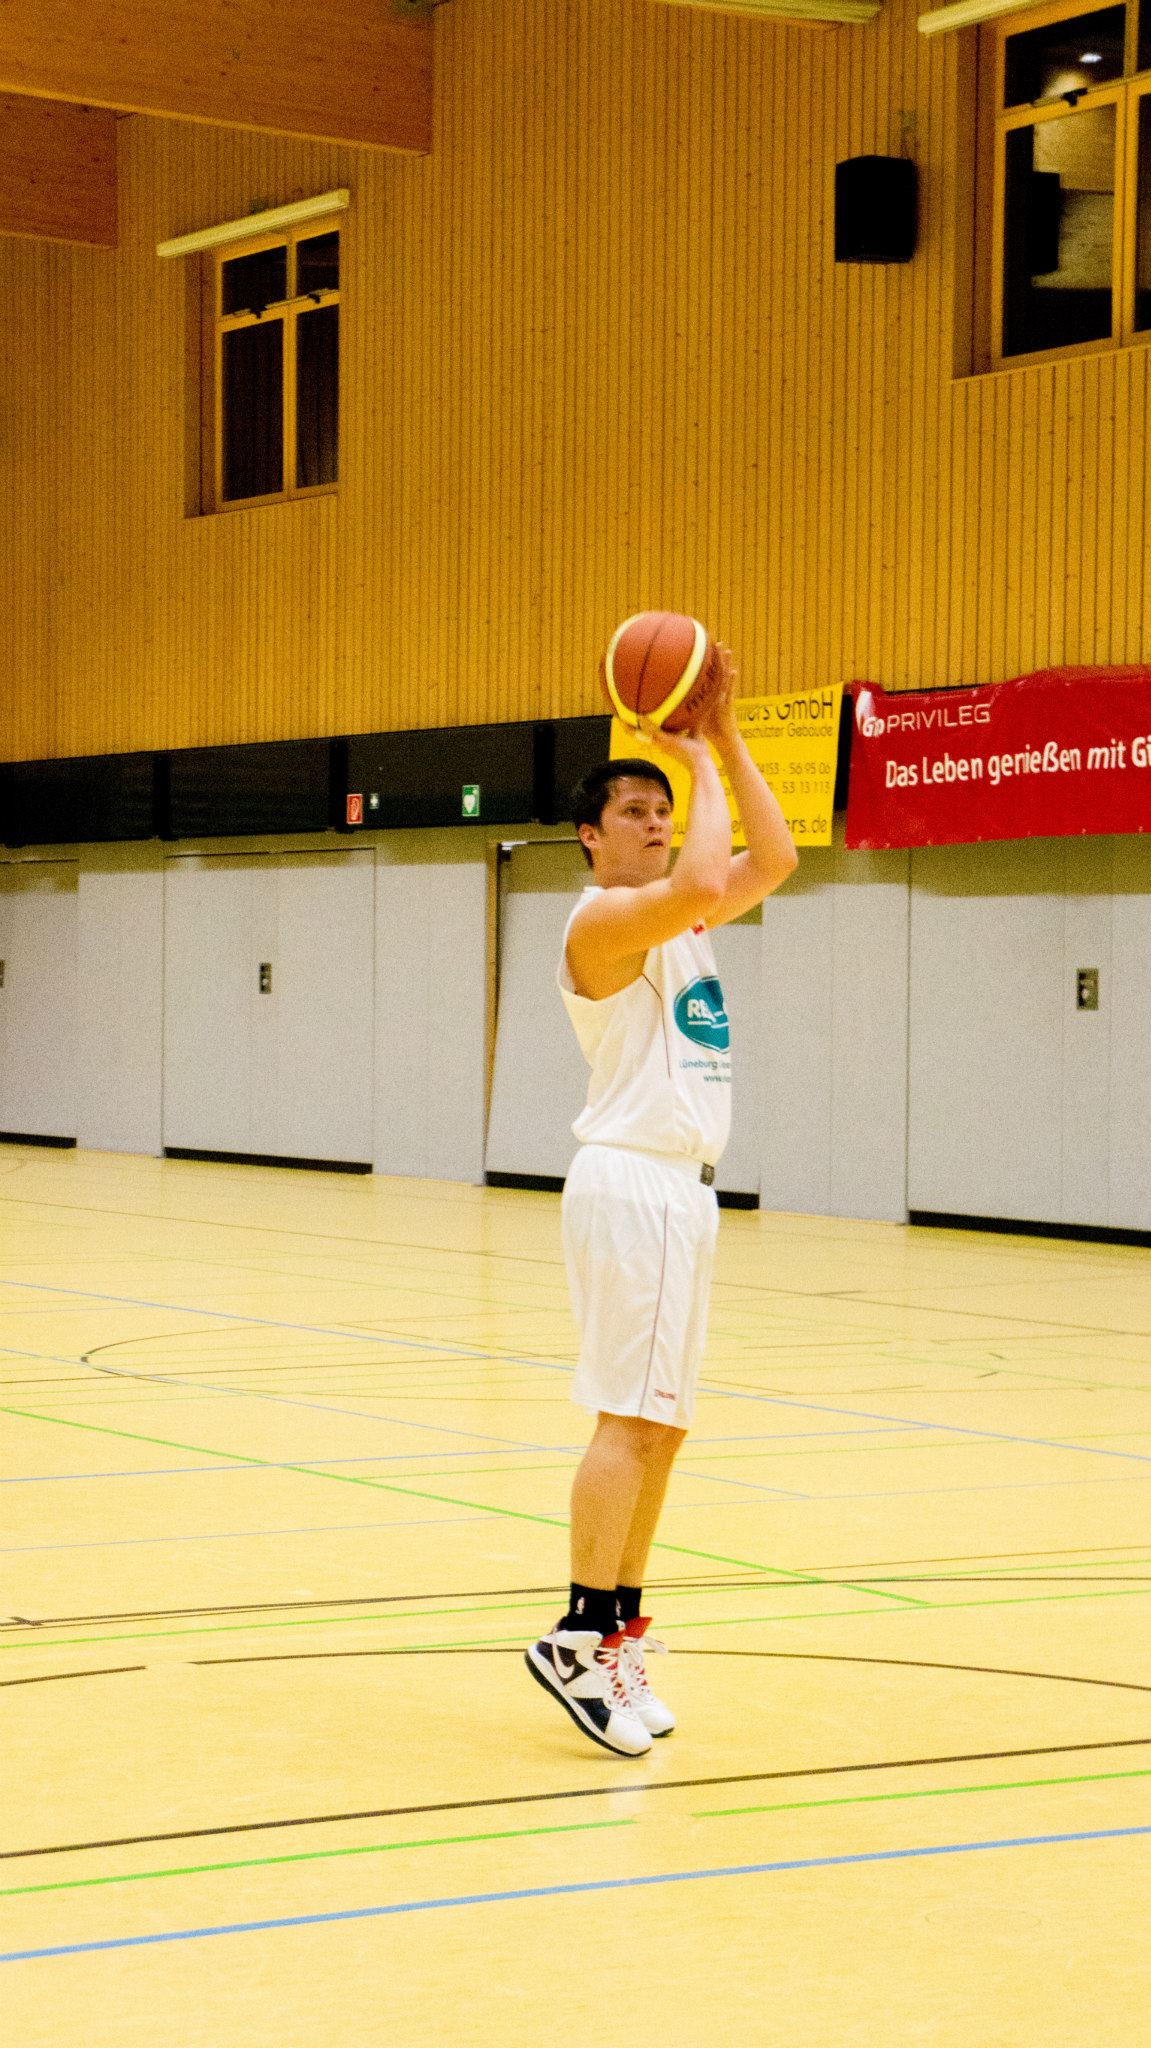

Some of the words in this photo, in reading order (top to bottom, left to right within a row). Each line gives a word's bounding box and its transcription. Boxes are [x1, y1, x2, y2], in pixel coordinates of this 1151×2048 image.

[776, 690, 833, 720] GmbH
[887, 703, 991, 733] PRIVILEG
[886, 760, 919, 789] Das
[922, 752, 984, 785] Leben
[988, 741, 1081, 786] genießen
[1086, 738, 1127, 769] mit
